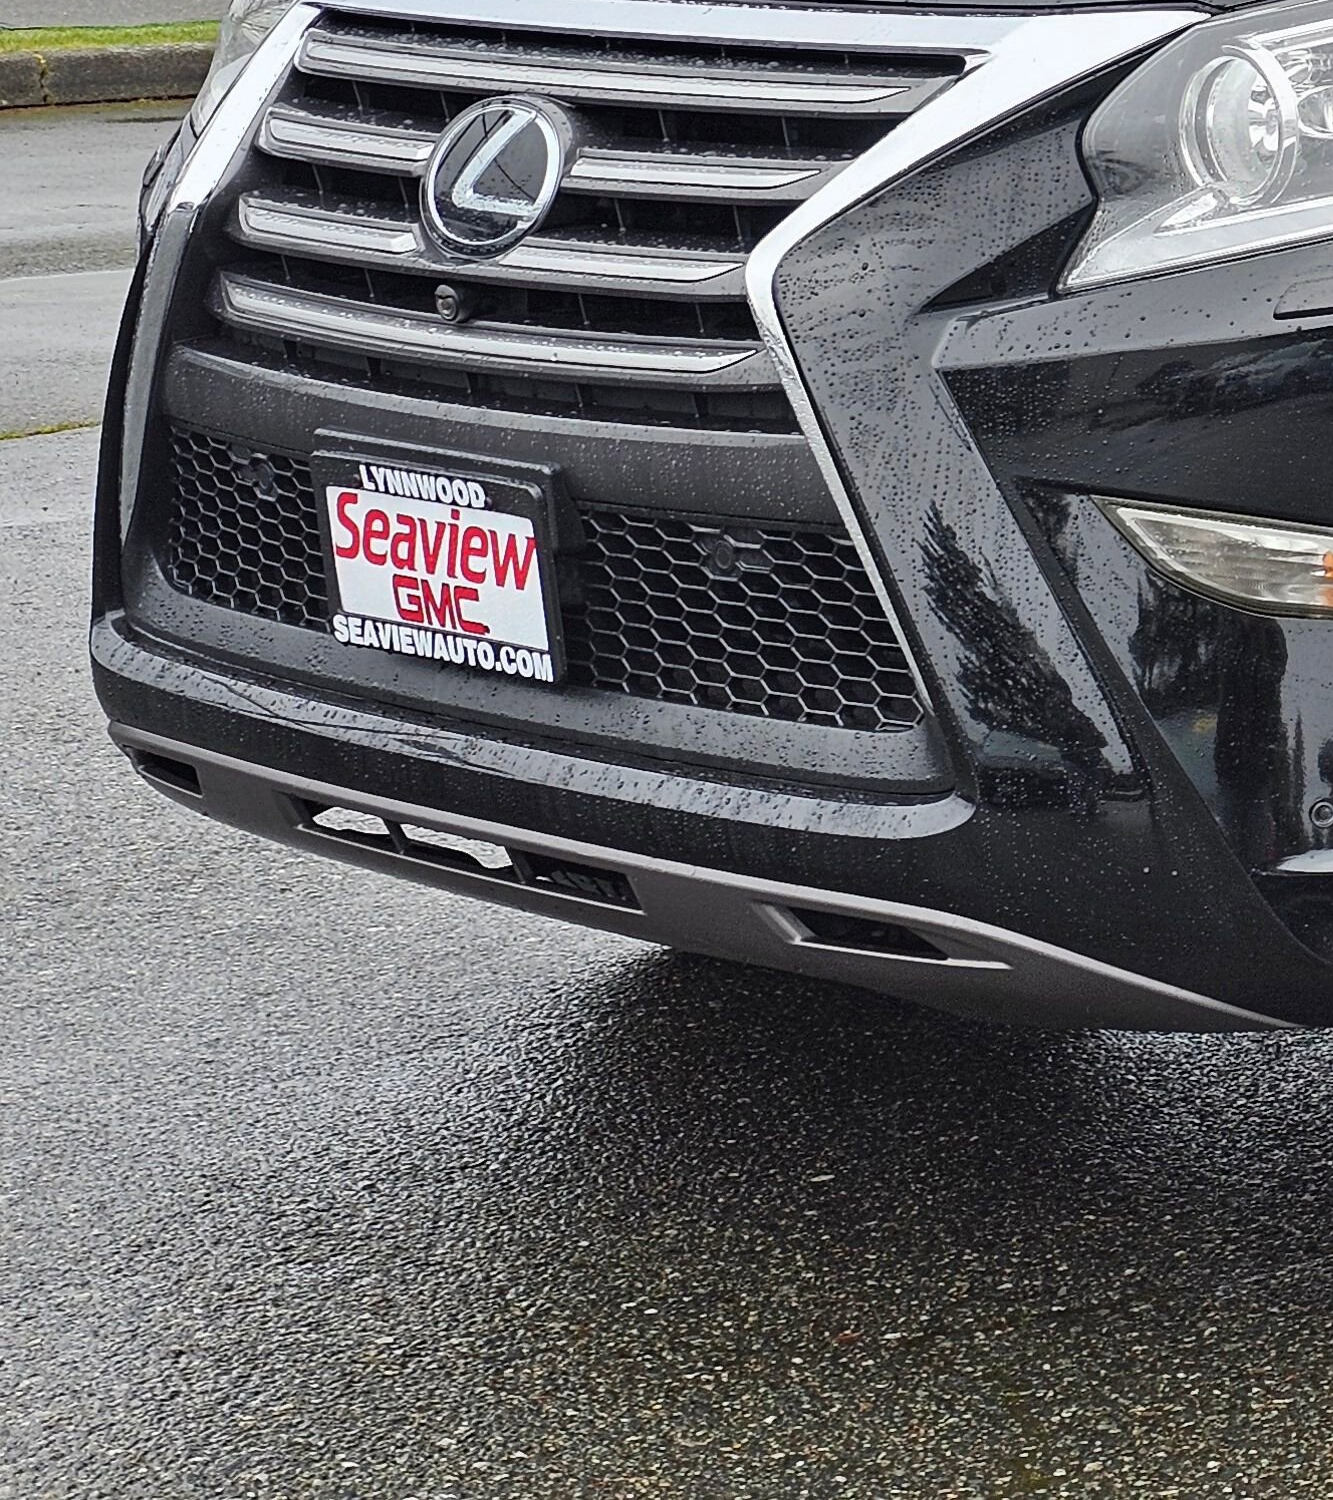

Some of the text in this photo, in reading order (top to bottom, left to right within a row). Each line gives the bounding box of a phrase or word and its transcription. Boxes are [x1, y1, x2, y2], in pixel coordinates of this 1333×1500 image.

[359, 464, 486, 508] LYNNWOOD
[335, 491, 537, 591] Seaview
[392, 573, 490, 635] GMC
[333, 614, 554, 683] SEAVIEWAUTO.COM
